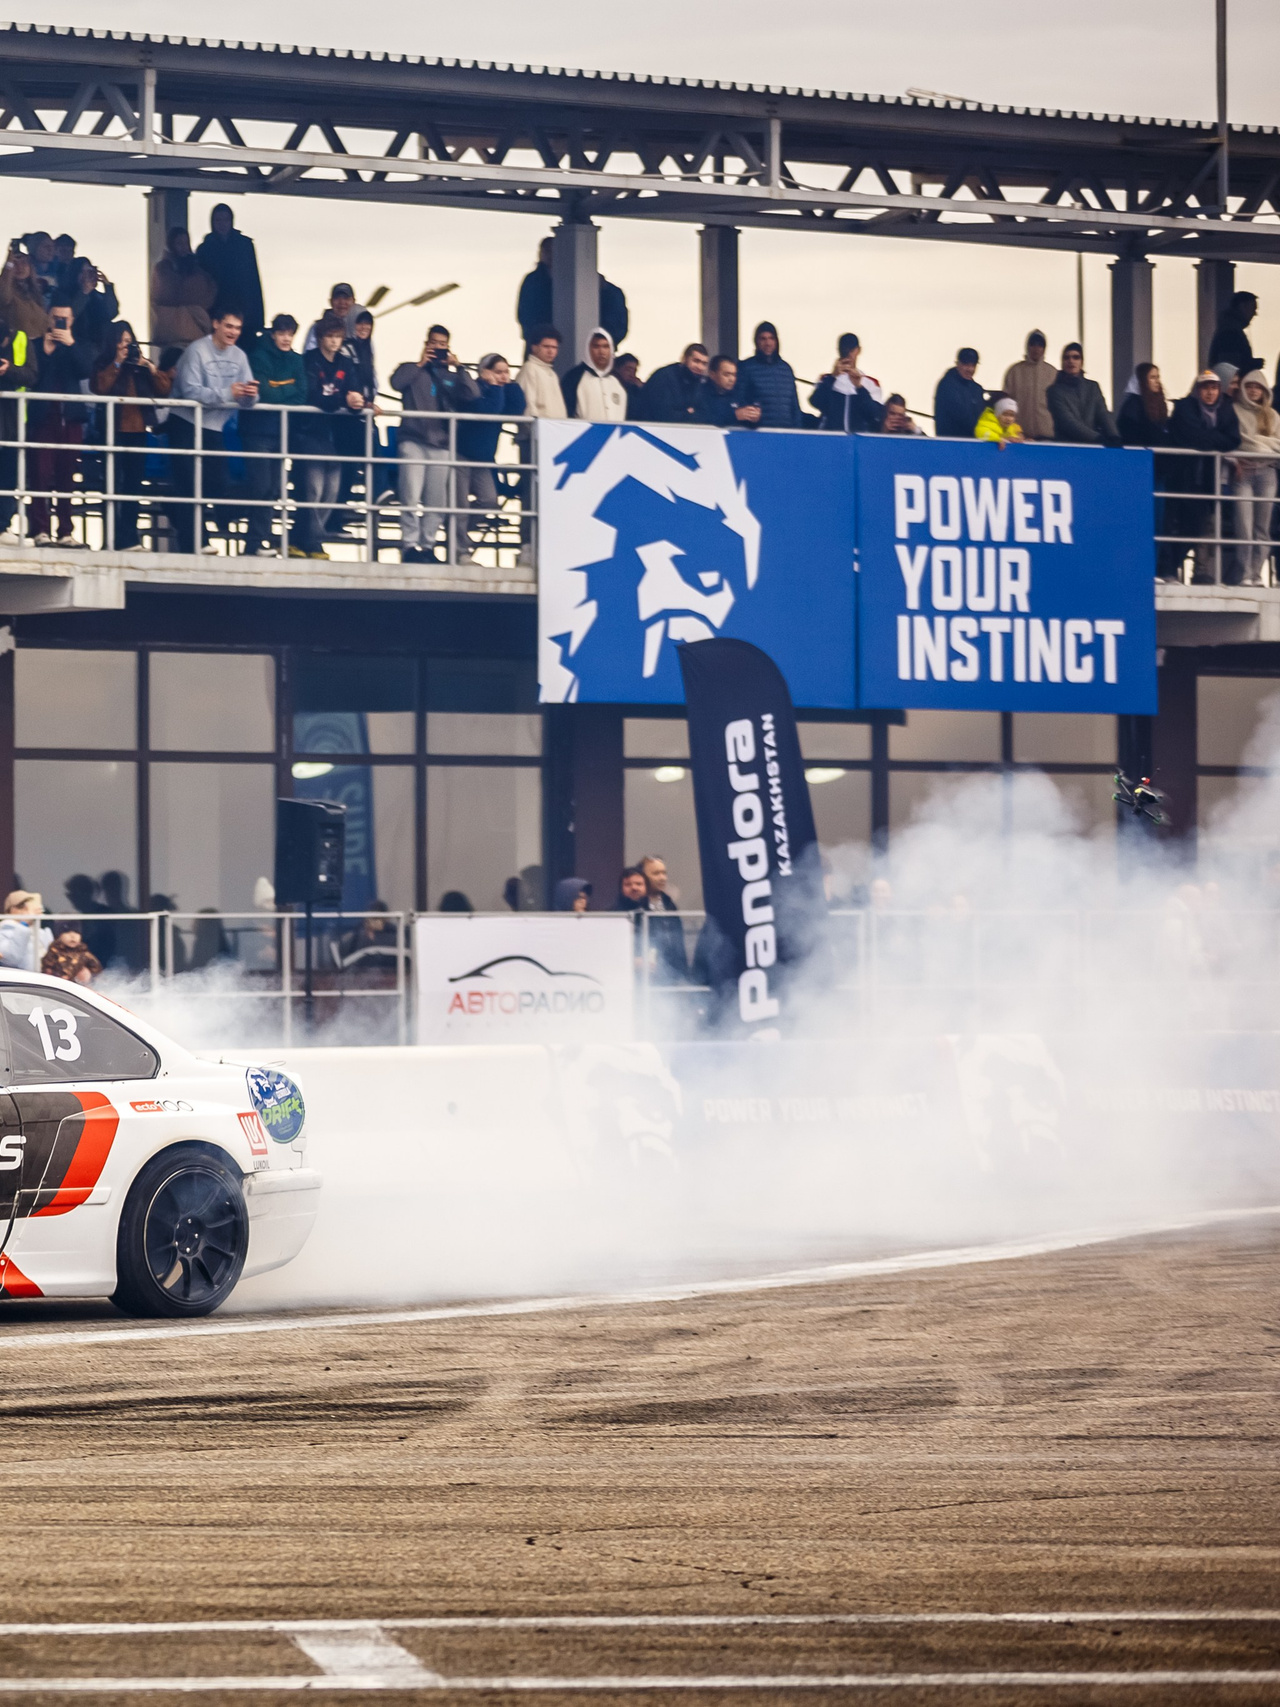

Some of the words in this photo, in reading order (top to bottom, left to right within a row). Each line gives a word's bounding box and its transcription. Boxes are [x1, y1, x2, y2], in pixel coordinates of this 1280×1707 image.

[893, 474, 1074, 545] POWER
[894, 545, 1032, 613] YOUR
[896, 615, 1125, 685] INSTINCT
[761, 713, 793, 876] KAZAKHSTAN
[724, 718, 780, 1024] Pandora
[28, 1006, 81, 1062] 13
